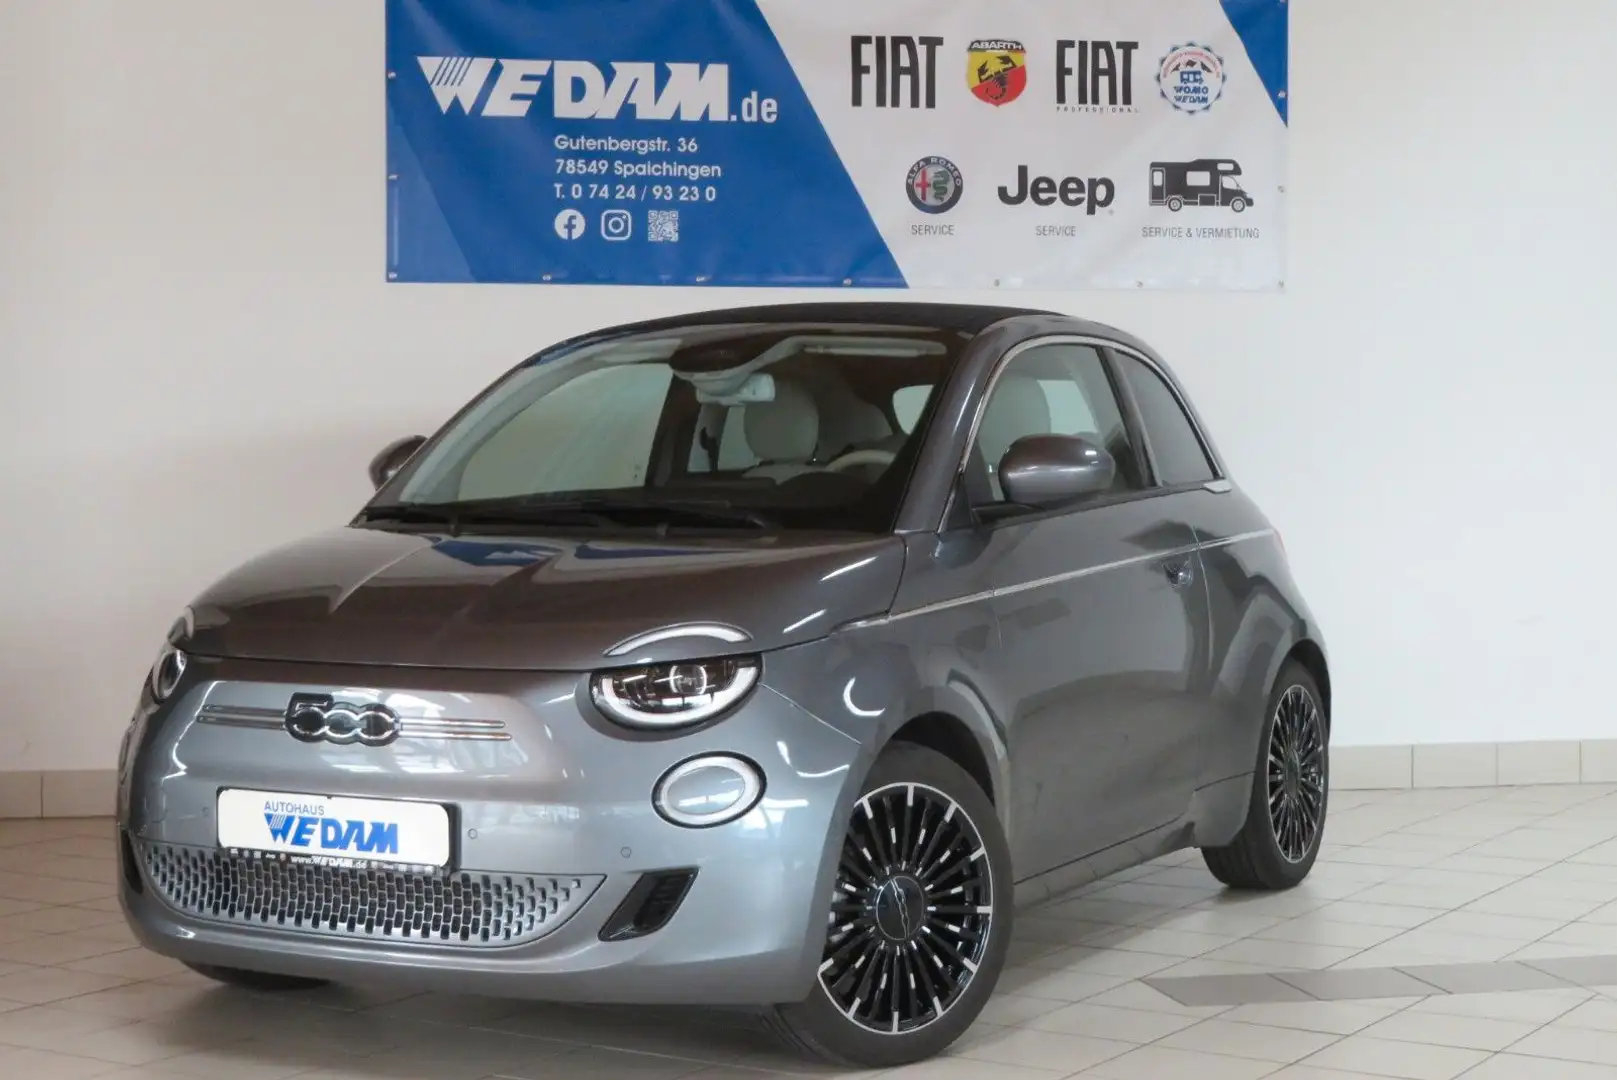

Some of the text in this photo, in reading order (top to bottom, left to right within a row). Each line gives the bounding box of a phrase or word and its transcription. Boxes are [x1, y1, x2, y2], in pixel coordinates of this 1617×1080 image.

[970, 41, 1022, 50] ABARTH
[851, 36, 944, 108] FIAT
[1056, 40, 1139, 105] FIAT
[554, 134, 698, 155] Gutenbergstr. 36
[555, 158, 722, 181] 78549 Spaichingen
[554, 183, 565, 199] T.
[571, 183, 582, 199] 0
[589, 184, 609, 199] 74
[615, 184, 636, 200] 24
[652, 185, 673, 201] 93
[679, 186, 700, 202] 23
[705, 186, 717, 202] 0
[997, 164, 1115, 216] Jeep
[911, 224, 955, 236] SERVICE
[1036, 225, 1076, 237] SERVICE
[1141, 226, 1260, 239] SERVICE & VERMIETUNG
[285, 692, 400, 748] 500
[264, 800, 325, 816] AUTOHAUS
[264, 813, 399, 855] WEDAM
